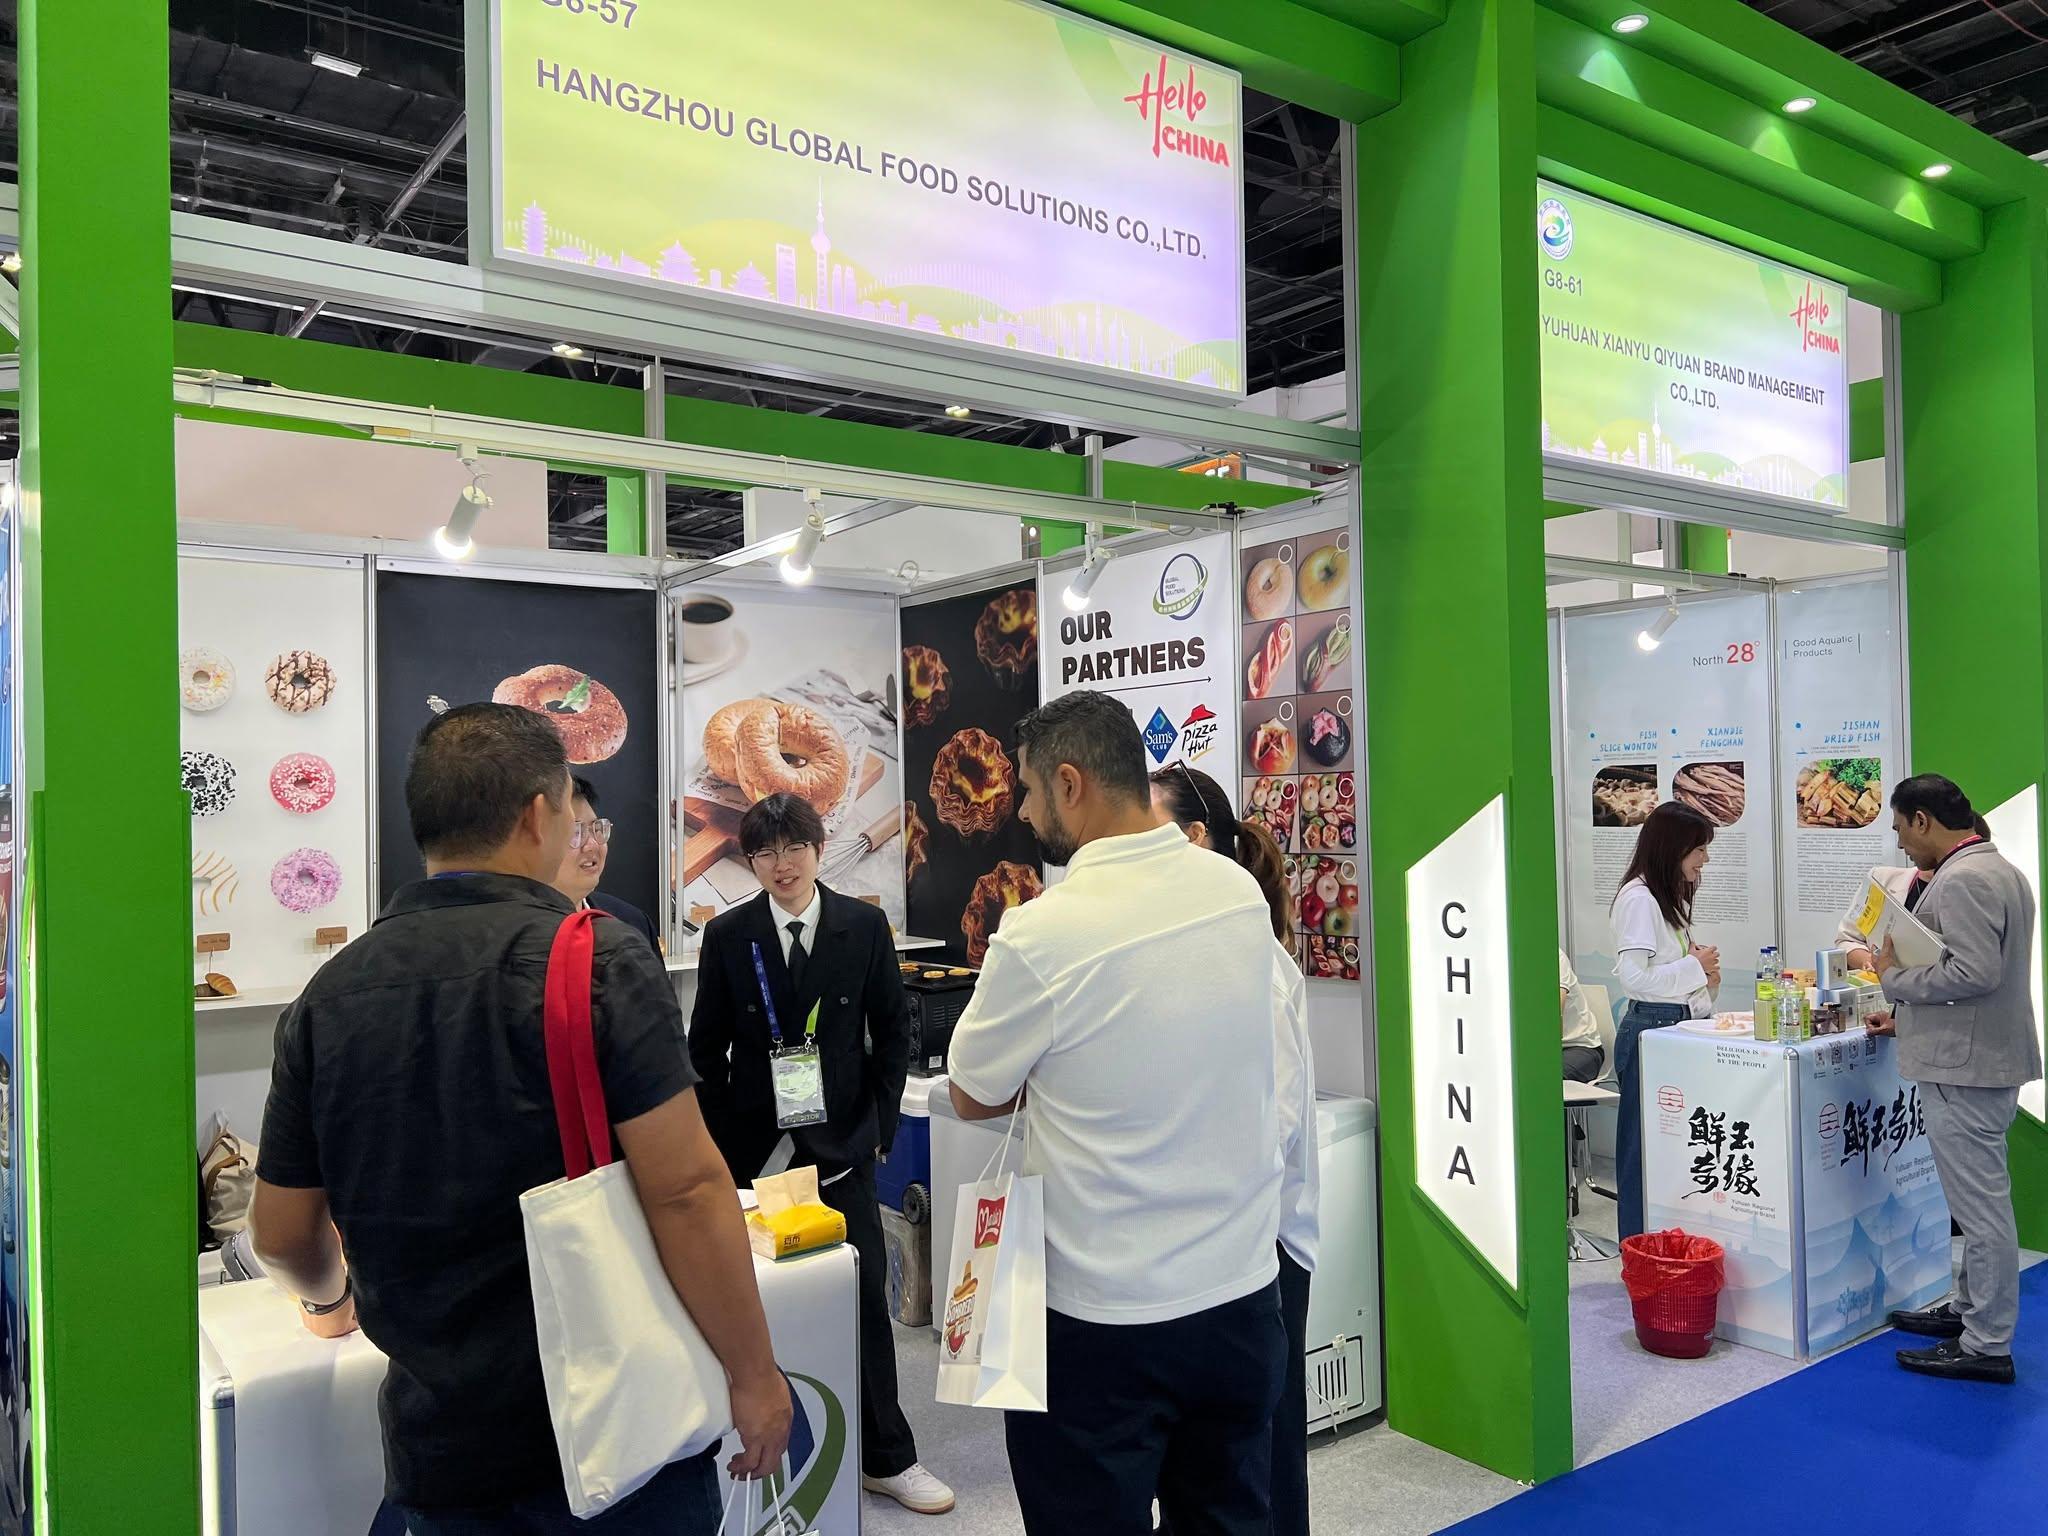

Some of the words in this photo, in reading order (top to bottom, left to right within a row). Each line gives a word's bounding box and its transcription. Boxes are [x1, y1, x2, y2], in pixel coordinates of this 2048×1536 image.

[542, 0, 637, 28] -57
[1124, 54, 1207, 158] Hello
[537, 58, 734, 137] HANGZHOU
[745, 117, 871, 174] GLOBAL
[881, 153, 958, 195] FOOD
[967, 176, 1109, 234] SOLUTIONS
[1117, 216, 1207, 259] CO.,LTD.
[1162, 126, 1230, 168] CHINA
[1544, 268, 1583, 296] G8-61
[1790, 280, 1829, 352] Hello
[1807, 330, 1840, 355] CHINA
[1542, 314, 1599, 347] YUHUAN
[1602, 331, 1650, 361] XIANYU
[1654, 347, 1701, 375] QIYUAN
[1704, 360, 1745, 385] BRAND
[1748, 372, 1825, 406] MANAGEMENT
[1670, 383, 1720, 409] CO.,LTD.
[1060, 610, 1112, 645] OUR
[1793, 639, 1816, 648] Good
[1818, 635, 1853, 647] Aquatic
[1793, 648, 1833, 657] Products
[1062, 636, 1206, 685] PARTNERS
[1692, 654, 1723, 667] North
[1145, 729, 1173, 745] Sam's
[1182, 722, 1218, 752] Pizza
[1639, 730, 1657, 740] FISH
[1842, 720, 1880, 730] JISHAN
[1857, 733, 1880, 742] FISH
[1188, 736, 1214, 757] Hut
[1624, 742, 1657, 751] WONTON
[1441, 901, 1476, 1185] CHINA
